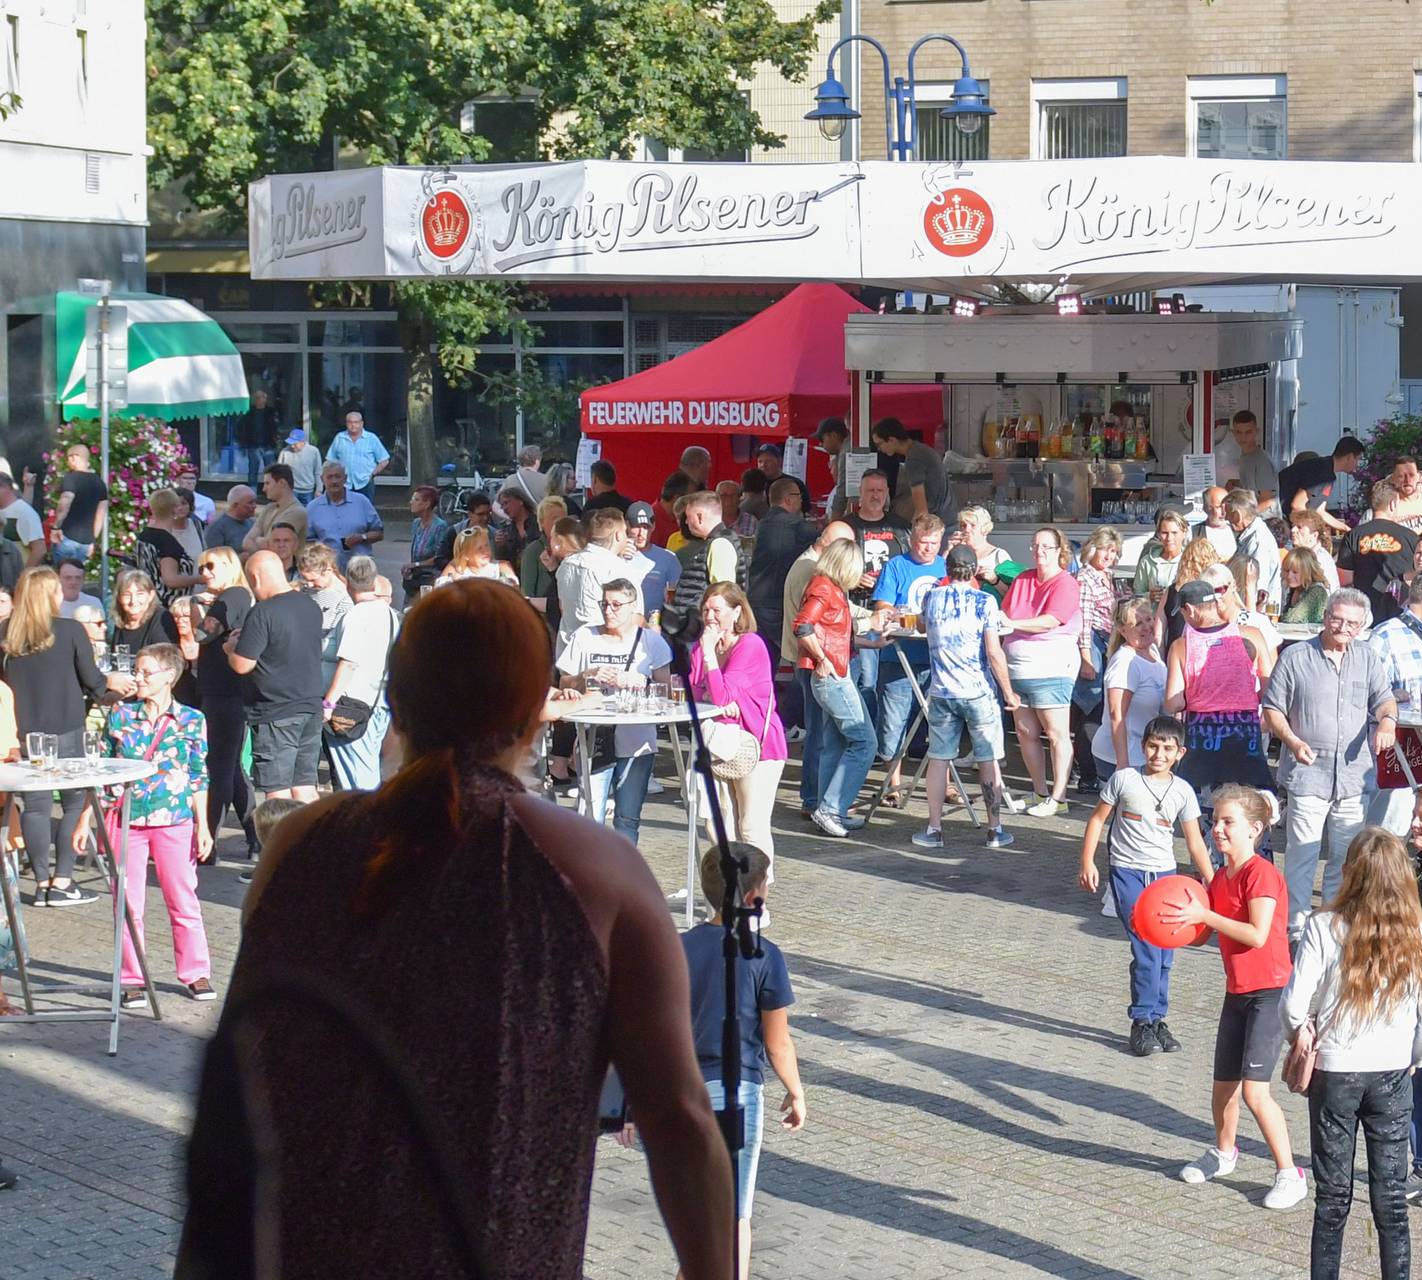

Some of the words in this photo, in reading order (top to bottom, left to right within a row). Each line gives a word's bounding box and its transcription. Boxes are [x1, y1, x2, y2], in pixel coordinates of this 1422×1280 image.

[285, 181, 366, 243] Pilsener
[493, 179, 622, 252] König
[625, 170, 819, 238] Pilsener
[1032, 176, 1199, 249] König
[1206, 171, 1396, 233] Pilsener
[588, 401, 684, 425] FEUERWEHR
[688, 401, 780, 428] DUISBURG
